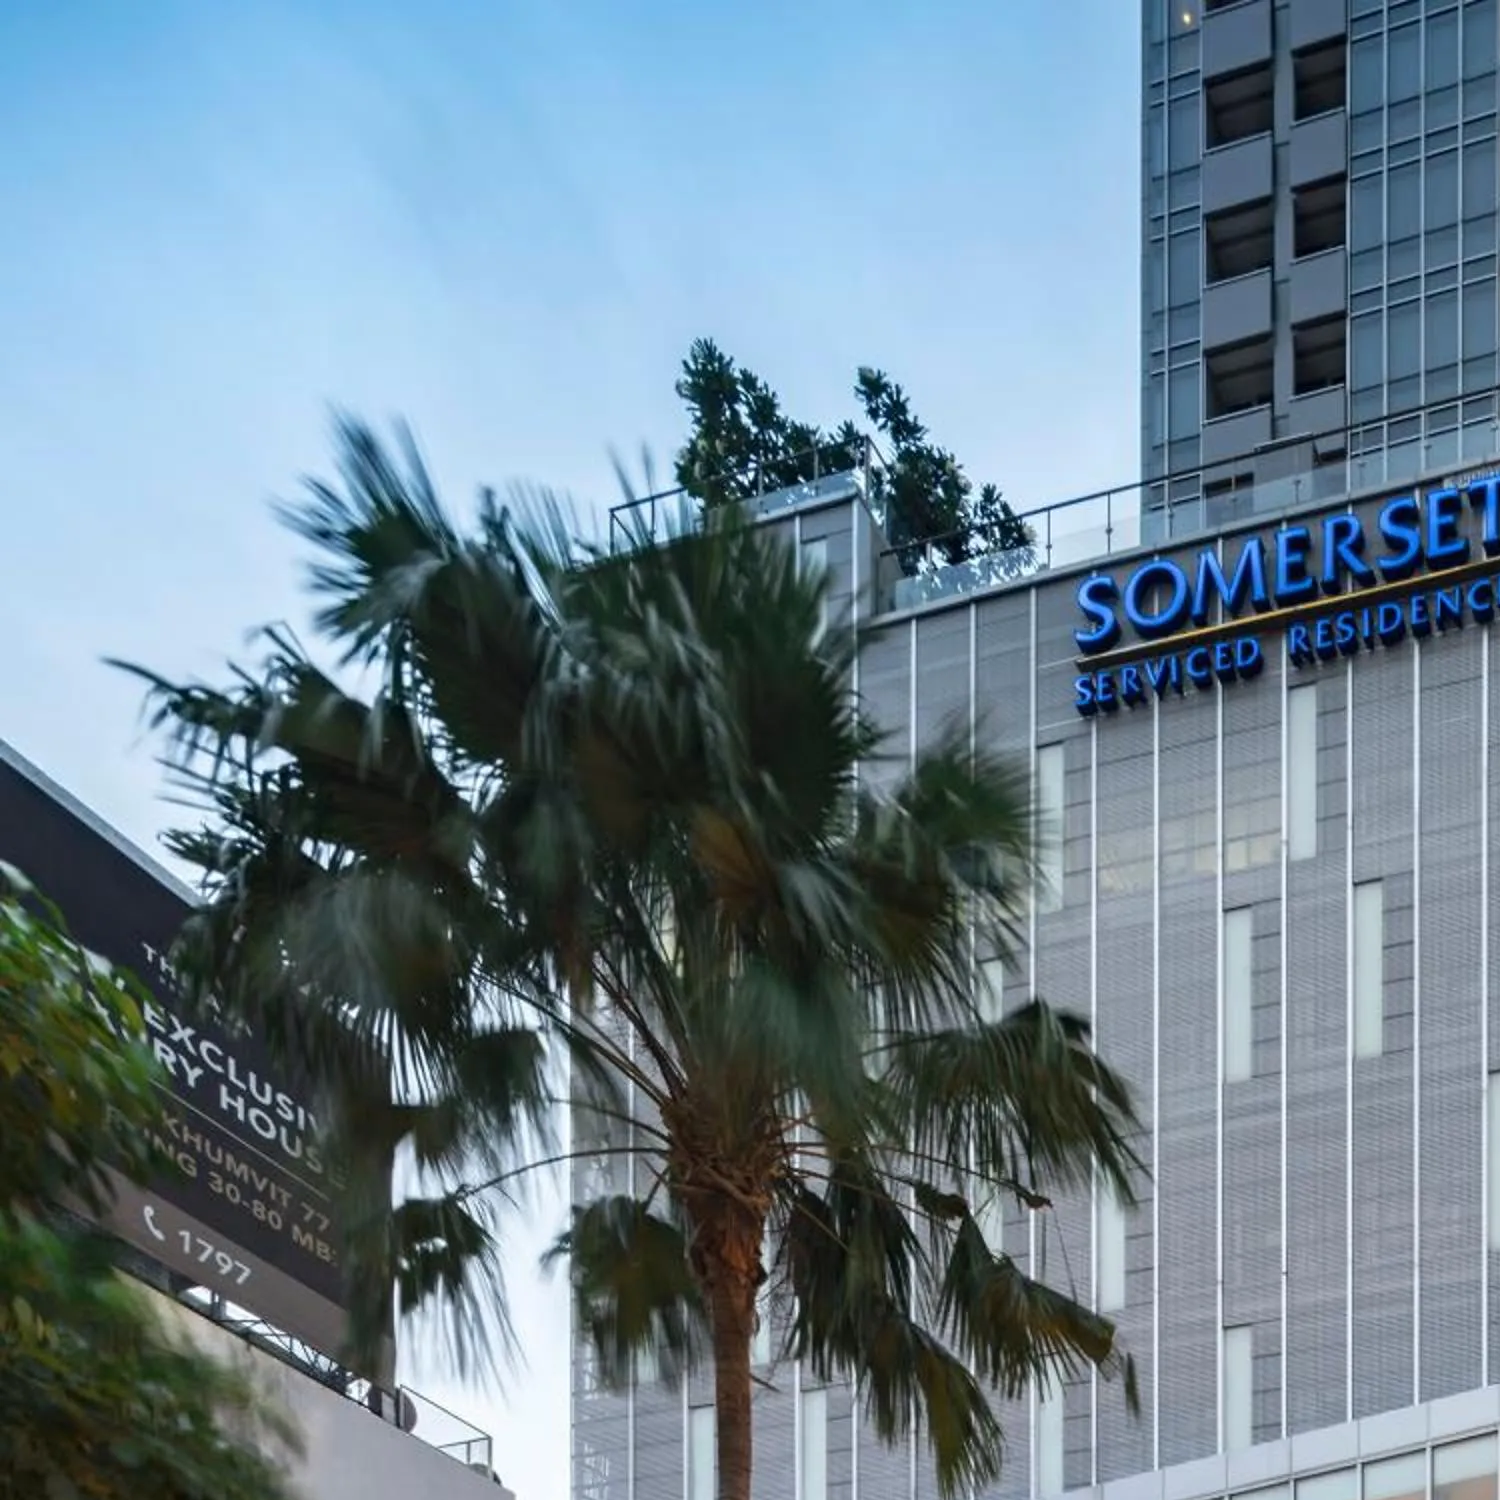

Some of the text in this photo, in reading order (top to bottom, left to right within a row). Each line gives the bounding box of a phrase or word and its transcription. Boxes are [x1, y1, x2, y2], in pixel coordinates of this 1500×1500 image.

[1074, 636, 1264, 716] SERVICED
[161, 1110, 293, 1207] KHUMVIT
[301, 1203, 331, 1232] 77
[208, 1170, 283, 1230] 30-80
[178, 1230, 252, 1285] 1797
